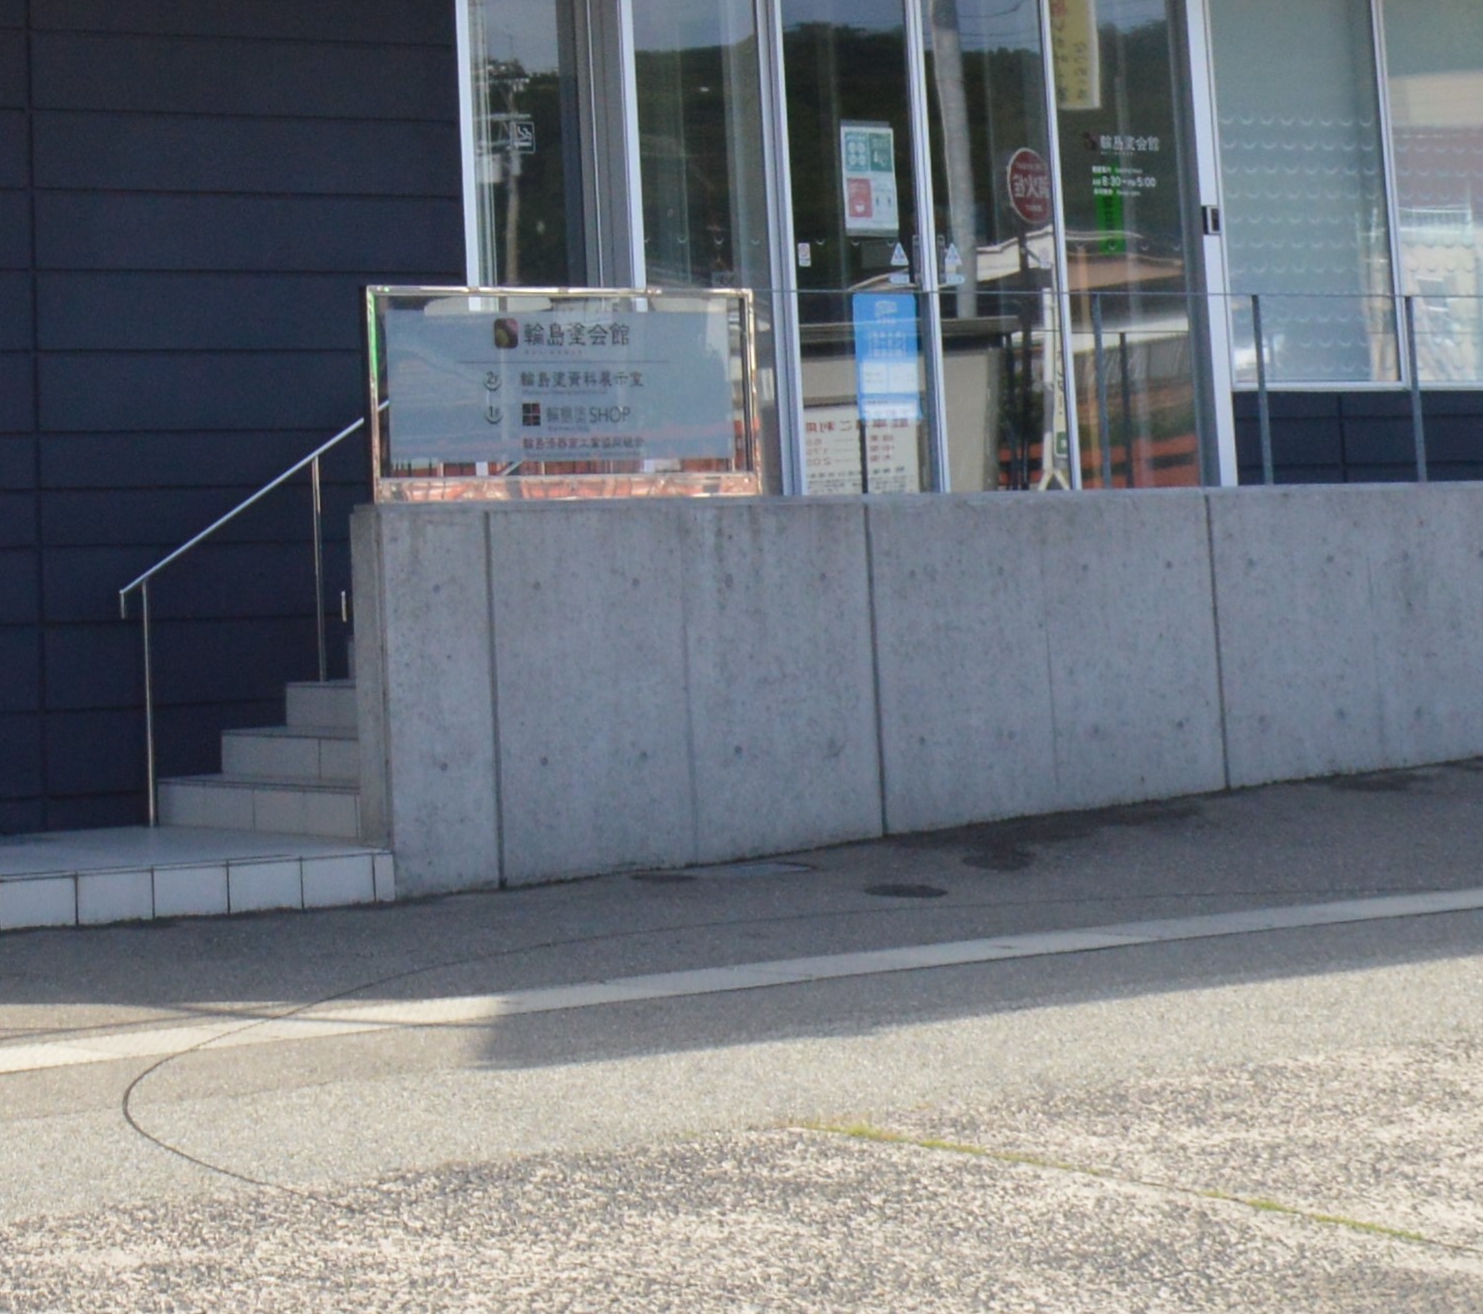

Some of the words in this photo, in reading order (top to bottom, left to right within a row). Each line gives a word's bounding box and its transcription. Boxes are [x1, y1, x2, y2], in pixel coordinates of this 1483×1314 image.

[523, 322, 631, 347] 輪島塗会館
